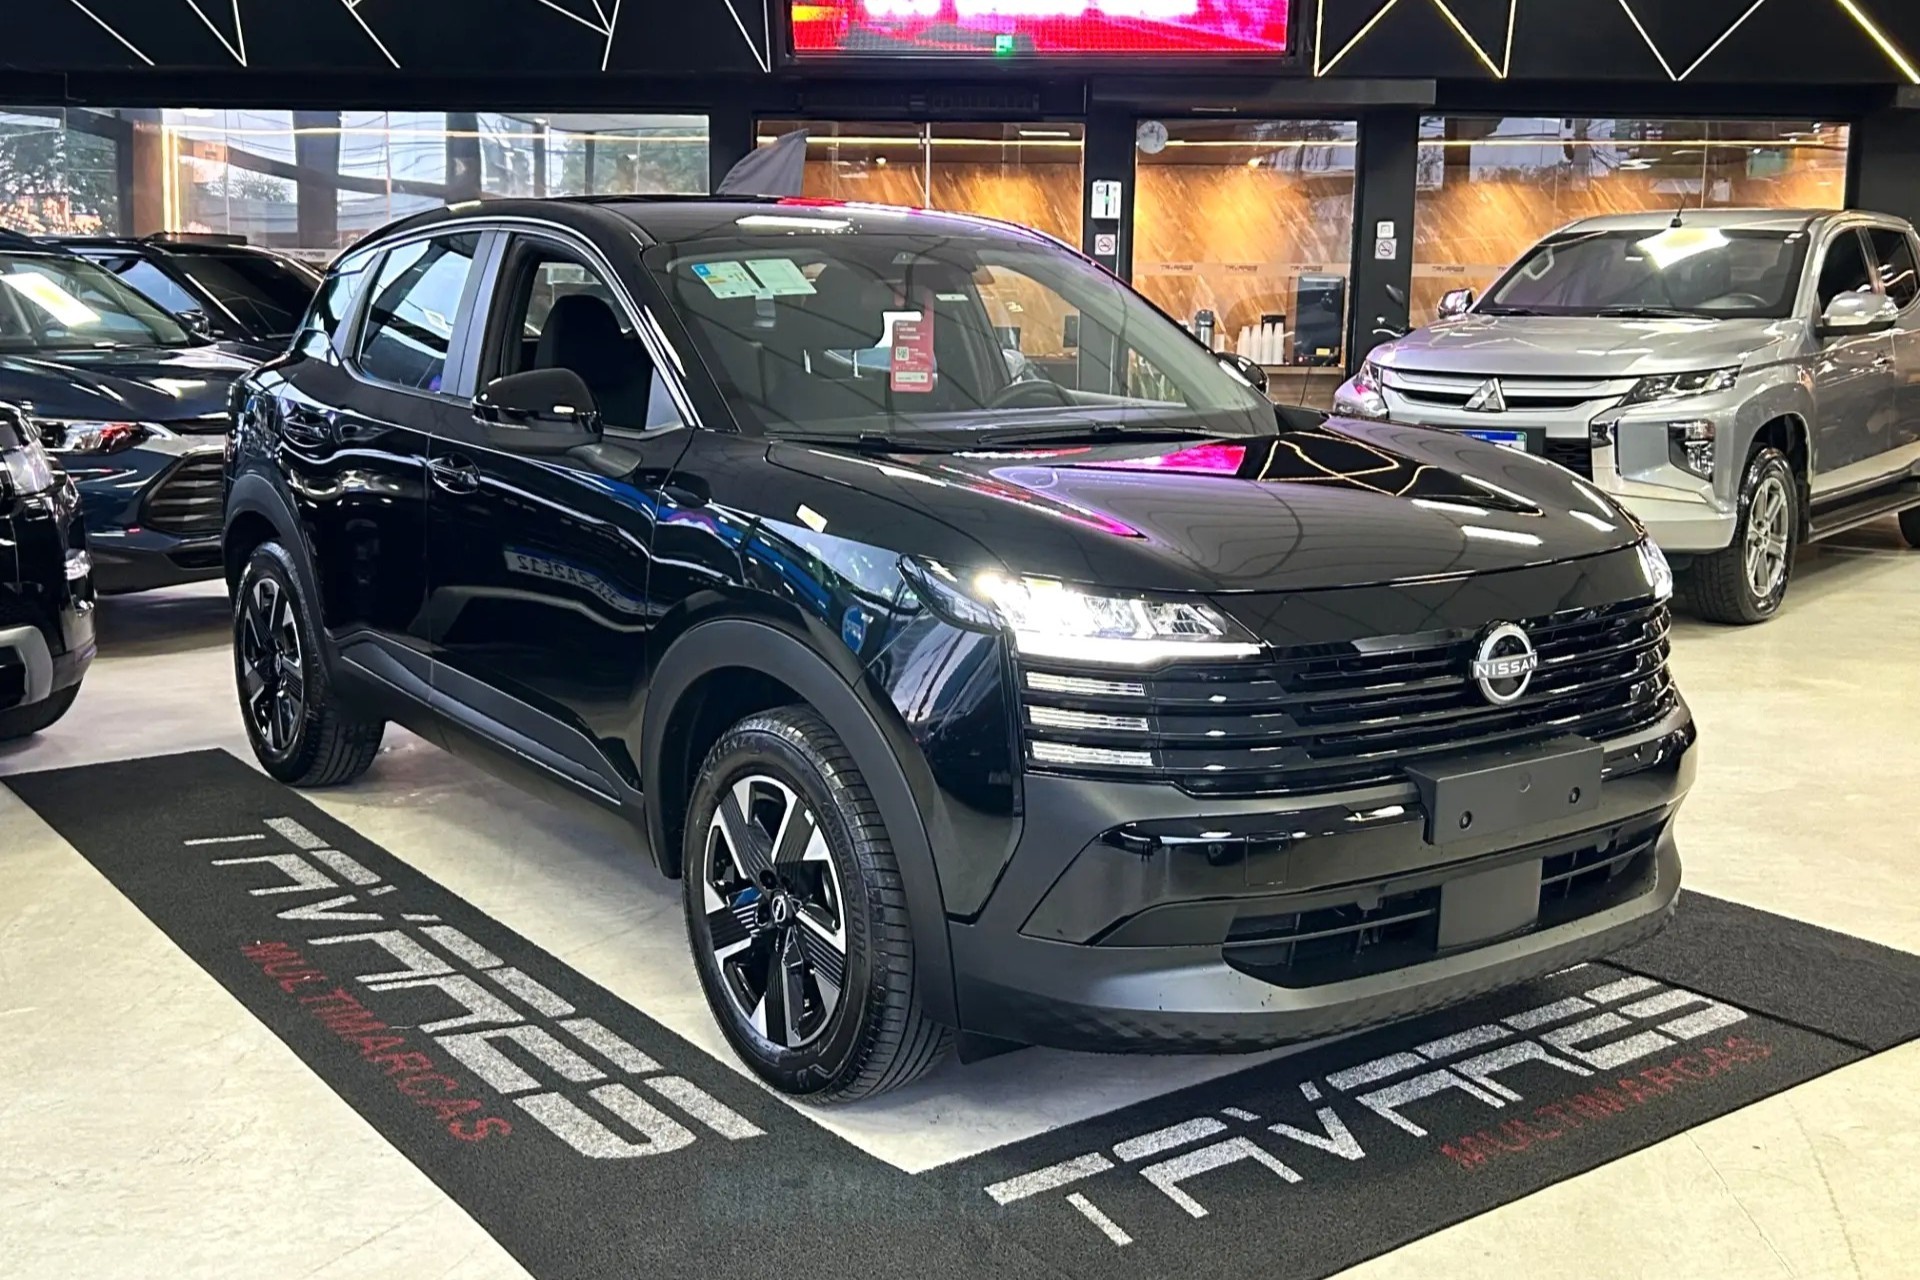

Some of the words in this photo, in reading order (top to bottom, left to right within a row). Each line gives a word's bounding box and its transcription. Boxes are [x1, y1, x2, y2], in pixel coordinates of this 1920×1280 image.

[1475, 655, 1538, 677] NISSAN
[184, 816, 768, 1160] TAVARES
[239, 940, 512, 1141] MULTIMARCAS
[983, 974, 1749, 1247] TAVARES
[1440, 1036, 1773, 1170] MULTIMARCAS
